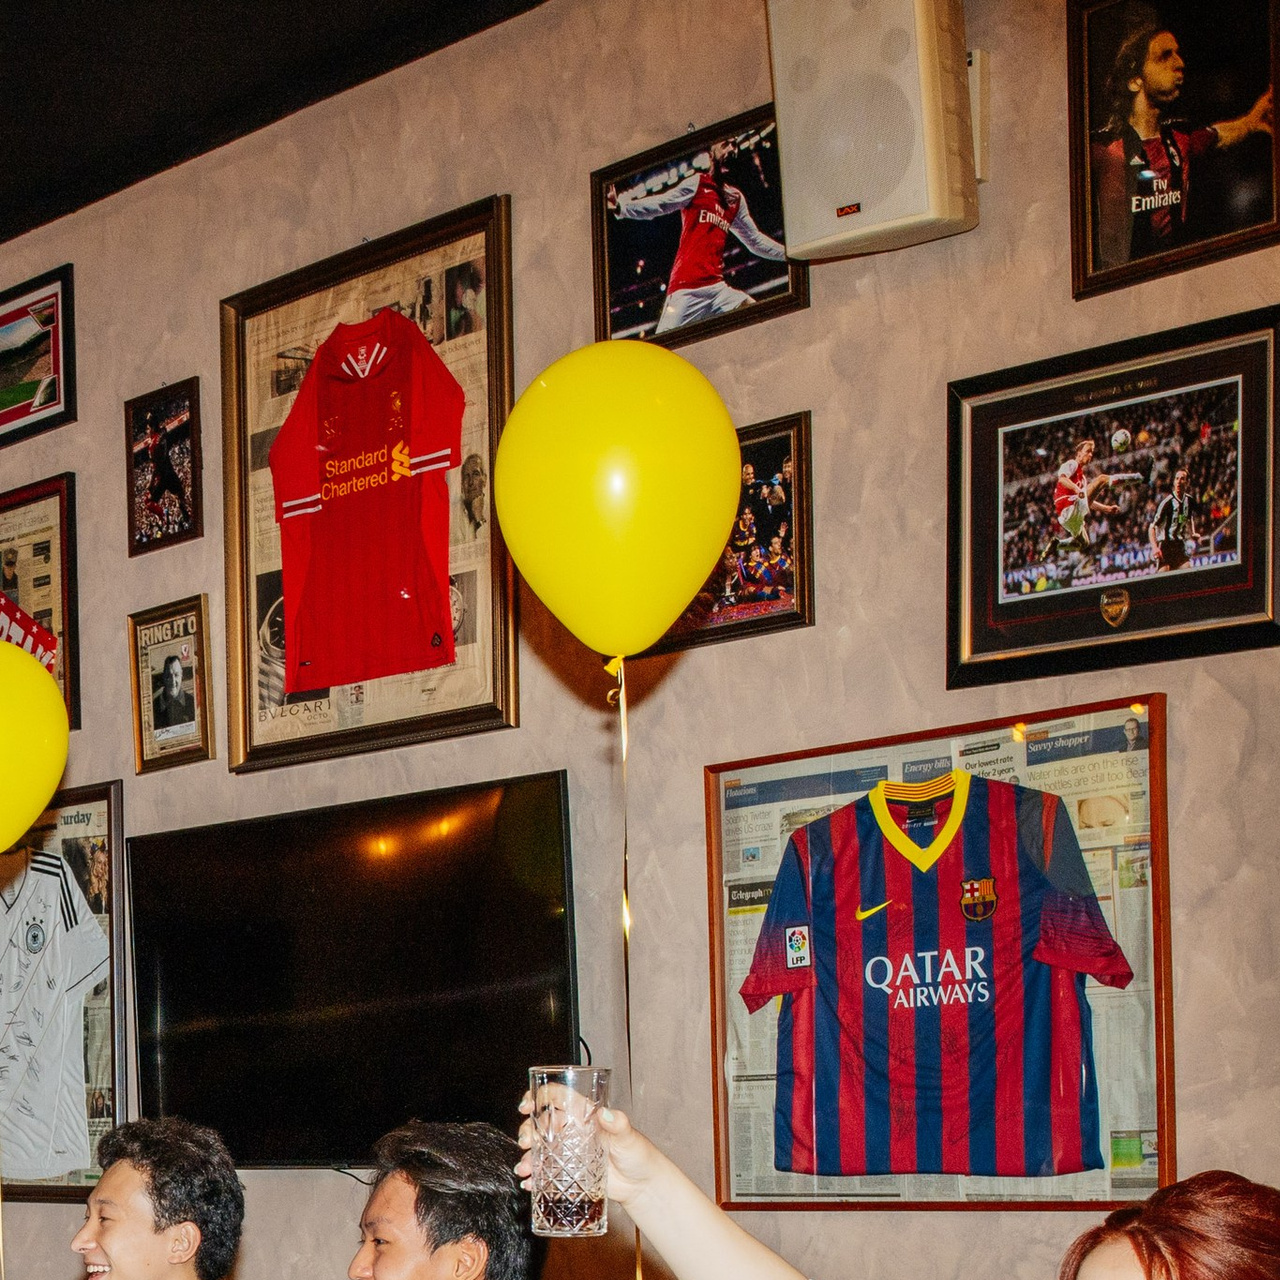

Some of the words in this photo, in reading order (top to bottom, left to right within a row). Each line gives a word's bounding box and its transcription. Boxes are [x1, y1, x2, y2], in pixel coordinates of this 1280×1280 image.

[1153, 179, 1168, 191] Fly
[837, 204, 858, 216] LAX
[1131, 191, 1182, 213] Emirates
[325, 444, 388, 478] Standard
[321, 467, 388, 500] Chartered
[141, 625, 171, 647] RING
[173, 618, 187, 639] IT
[1027, 740, 1054, 753] Savvy
[1054, 734, 1090, 750] shopper
[904, 761, 934, 773] Energy
[934, 758, 951, 769] bills
[965, 761, 977, 771] Our
[978, 758, 999, 768] lowest
[999, 755, 1014, 764] rate
[981, 769, 991, 778] for
[991, 768, 997, 777] 2
[997, 766, 1015, 777] years
[1027, 769, 1051, 782] Water
[1054, 765, 1068, 777] bills
[1070, 763, 1086, 774] are
[1087, 761, 1100, 772] on
[1102, 758, 1119, 770] the
[1121, 755, 1139, 767] rise
[1043, 778, 1073, 792] bottles
[1073, 777, 1088, 787] are
[1091, 774, 1105, 786] still
[1107, 771, 1124, 781] too
[731, 888, 763, 901] Telegraph
[791, 956, 806, 966] LFP
[865, 946, 988, 995] QATAR
[893, 981, 990, 1009] AIRWAYS
